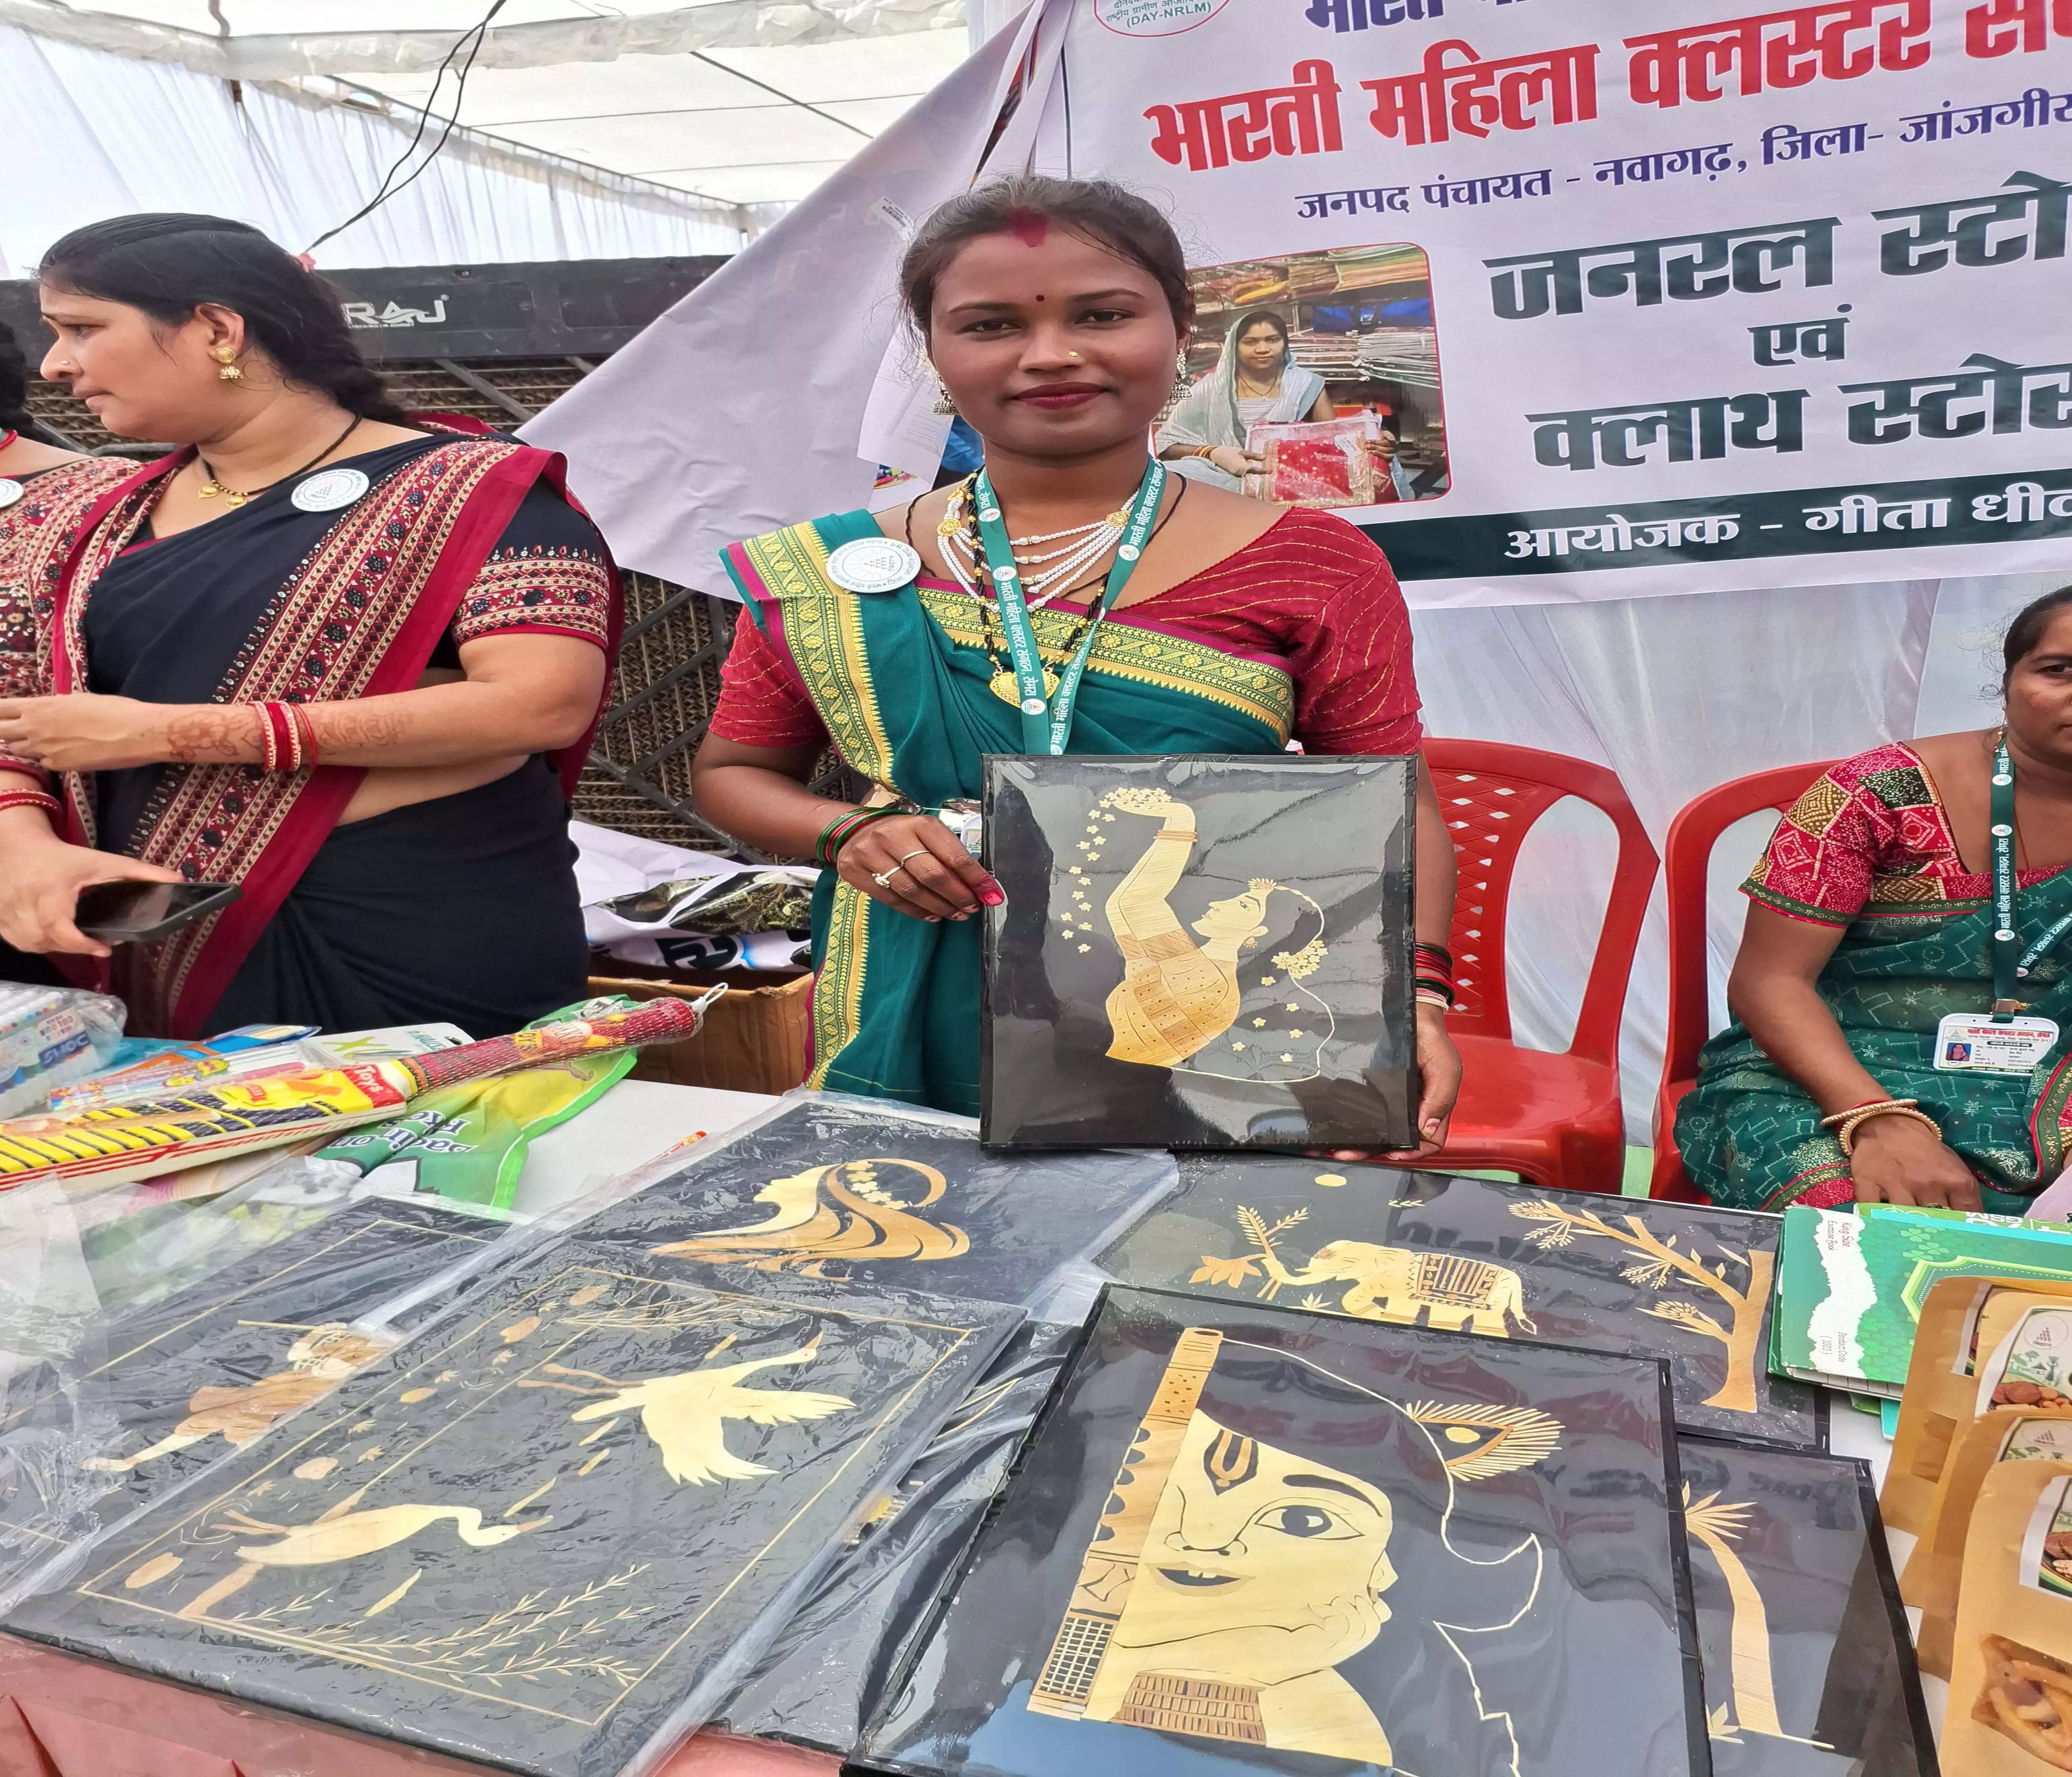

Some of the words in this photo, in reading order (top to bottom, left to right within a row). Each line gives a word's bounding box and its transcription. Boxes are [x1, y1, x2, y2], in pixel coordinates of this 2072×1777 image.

[1127, 2, 1211, 28] (DAY-NRLM)
[1143, 59, 1344, 172] भारती
[1359, 39, 1601, 146] महिला
[1622, 0, 1931, 109] क्लस्टर
[1295, 186, 1410, 219] जनपद
[1420, 174, 1552, 208] पंचायत
[1593, 143, 1747, 186] नवागढ़,
[1482, 216, 1843, 320] जनरल
[1870, 170, 2072, 277] स्टो
[1746, 303, 1854, 367] एवं
[1525, 388, 1811, 471] क्लाथ
[1134, 506, 1153, 525] महिला
[1129, 525, 1146, 546] भारती
[1505, 513, 1741, 559] आयोजक
[1802, 495, 1951, 534] गीता
[1000, 581, 1018, 602] भारती
[1006, 602, 1022, 624] महिला
[1010, 624, 1027, 648] क्लस्टर
[1023, 676, 1039, 696] सेमरा
[1054, 698, 1070, 722] महिला
[1051, 722, 1066, 744] भारती
[1998, 758, 2010, 774] भारती
[1995, 838, 2009, 853] सेमरा
[1999, 875, 2010, 894] क्लस्टर
[1997, 894, 2011, 912] महिला
[1997, 913, 2011, 929] भारती
[354, 1065, 383, 1093] Toys
[1839, 1222, 1853, 1234] King
[1965, 1212, 2023, 1224] GSM
[1825, 1240, 1838, 1251] Book
[1842, 1235, 1854, 1247] Size
[1838, 1332, 1848, 1349] Product
[1838, 1350, 1848, 1362] Code
